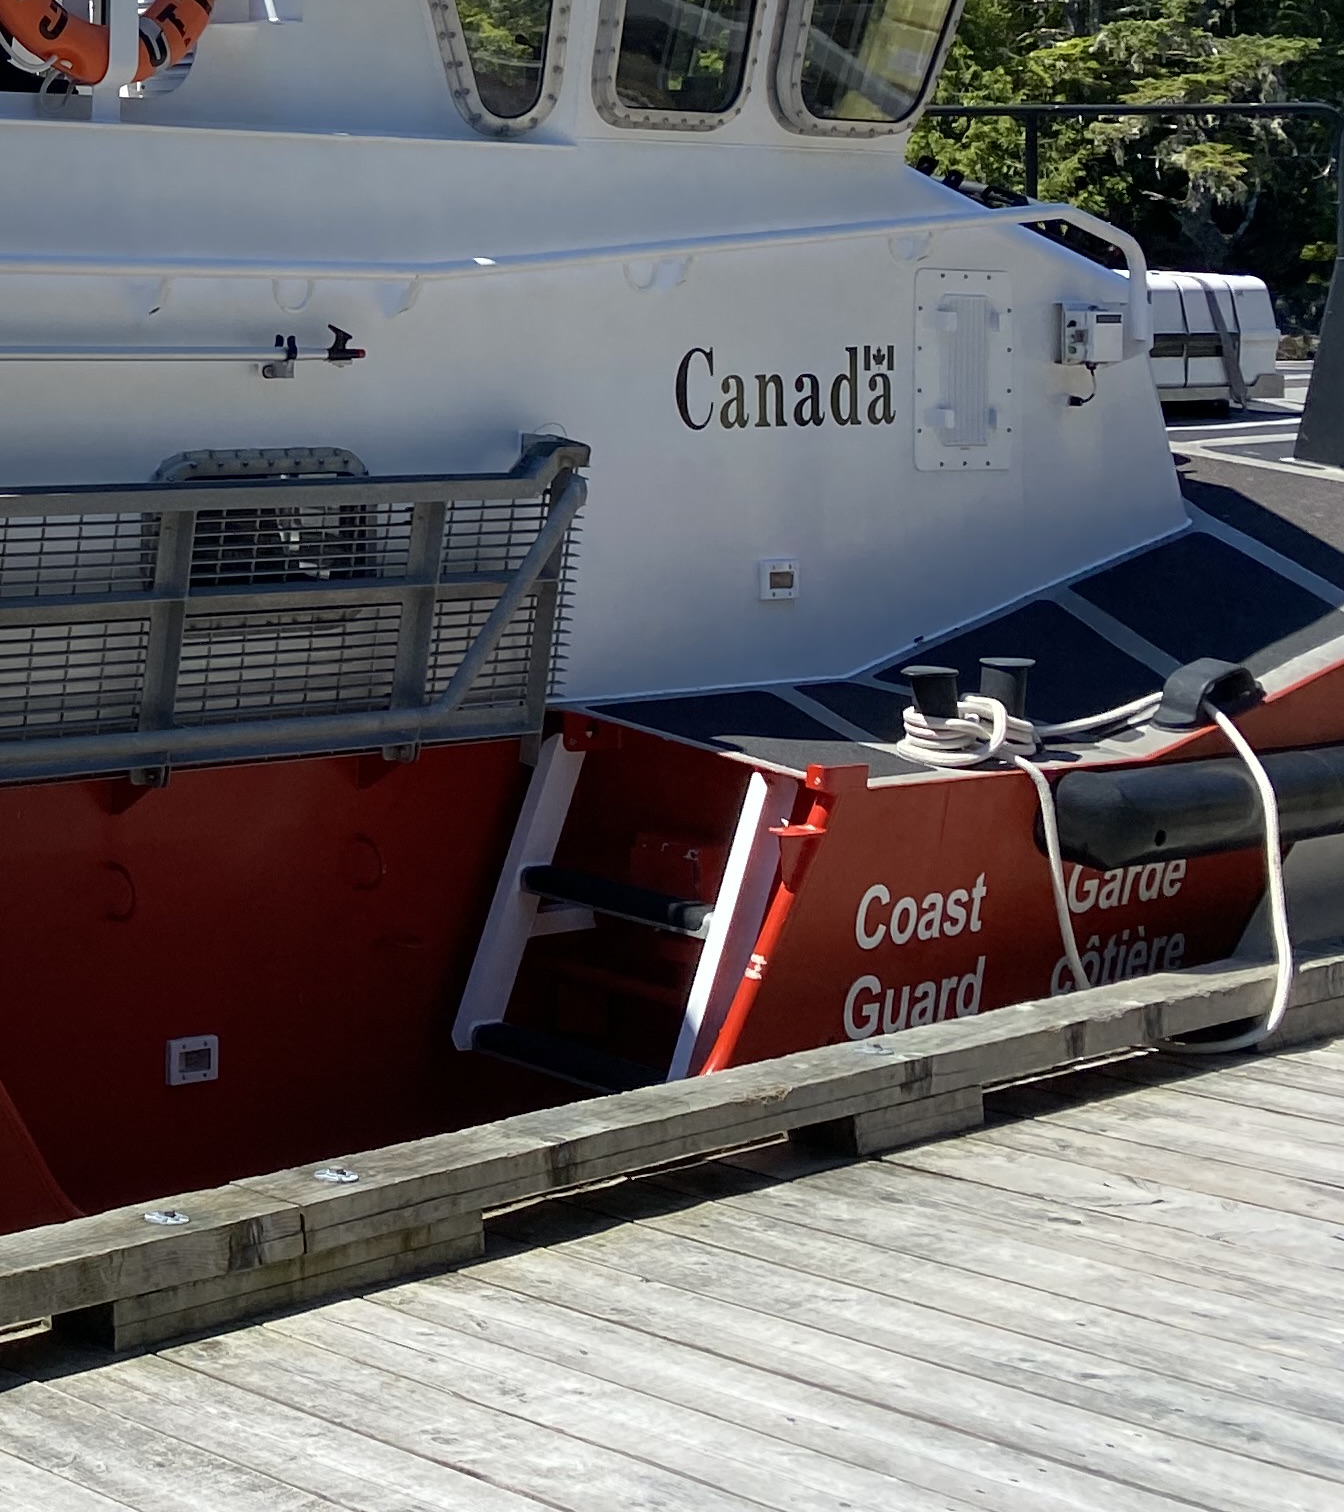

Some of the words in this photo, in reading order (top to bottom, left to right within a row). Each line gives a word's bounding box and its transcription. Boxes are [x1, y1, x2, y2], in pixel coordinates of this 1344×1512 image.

[674, 345, 898, 431] Canada
[855, 872, 987, 950] Coast
[1067, 858, 1188, 914] Garde
[843, 956, 987, 1040] Guard
